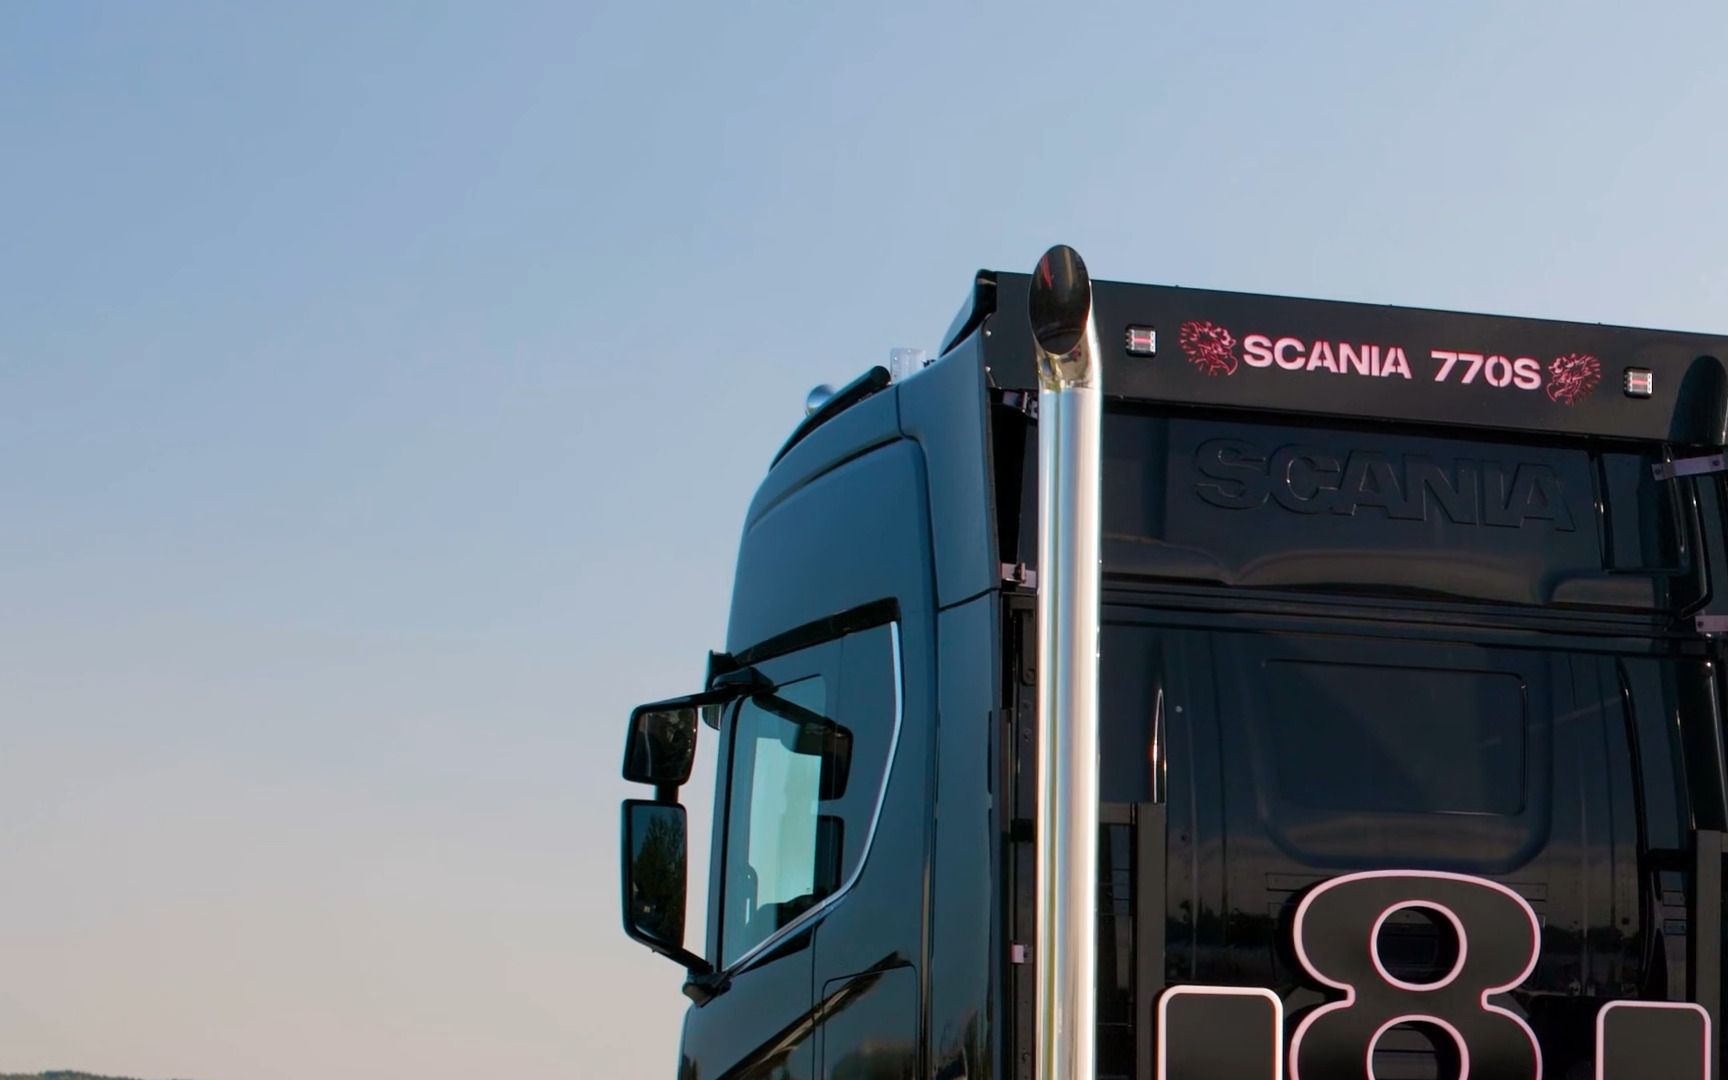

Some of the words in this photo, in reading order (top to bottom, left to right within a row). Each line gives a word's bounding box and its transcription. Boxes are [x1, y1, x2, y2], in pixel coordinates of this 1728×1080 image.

[1243, 334, 1412, 380] SCANIA
[1430, 350, 1542, 391] 770S
[1195, 436, 1577, 533] SCANIA
